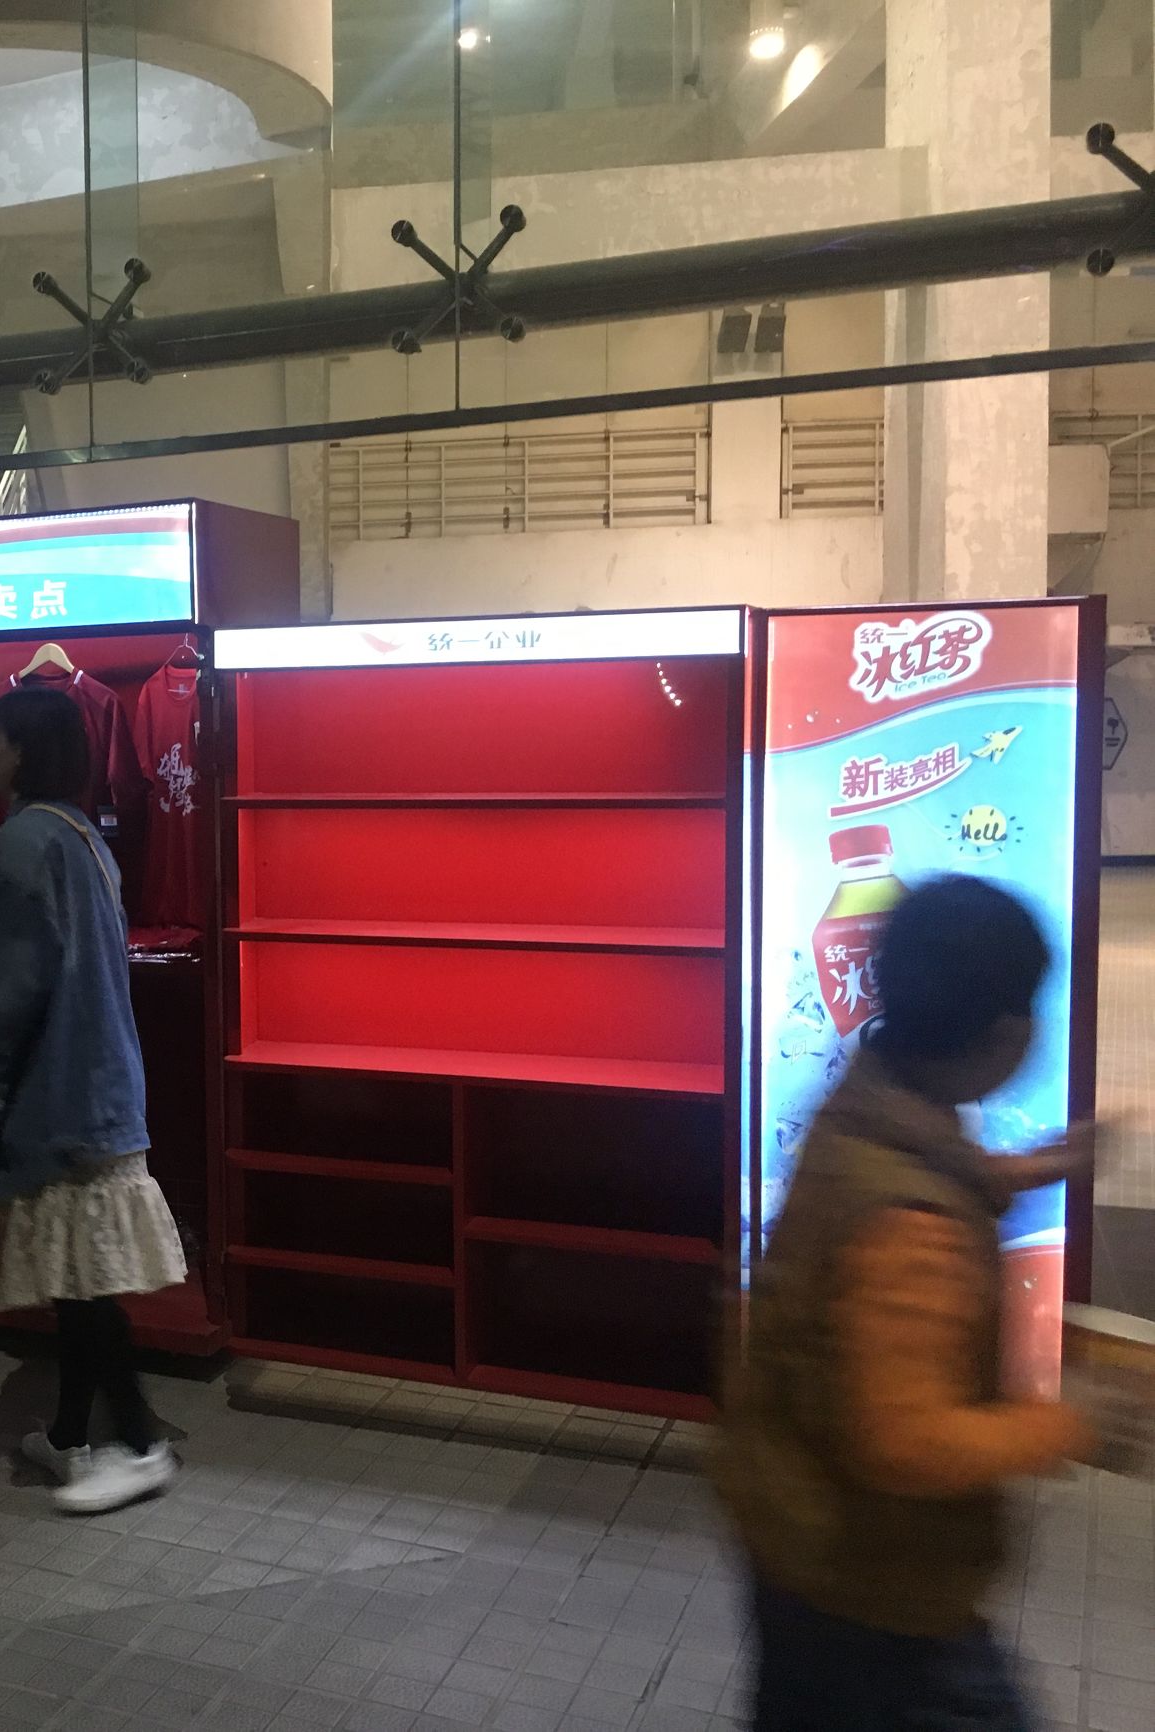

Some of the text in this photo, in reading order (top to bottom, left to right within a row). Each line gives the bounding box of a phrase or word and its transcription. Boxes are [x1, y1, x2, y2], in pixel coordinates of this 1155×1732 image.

[428, 629, 542, 652] 统一企业
[860, 628, 908, 644] 统一
[857, 618, 983, 698] 冰红茶
[894, 672, 947, 693] Ice Tea
[842, 746, 956, 798] 新装亮相
[961, 822, 1007, 842] Hello
[824, 944, 870, 962] 统一
